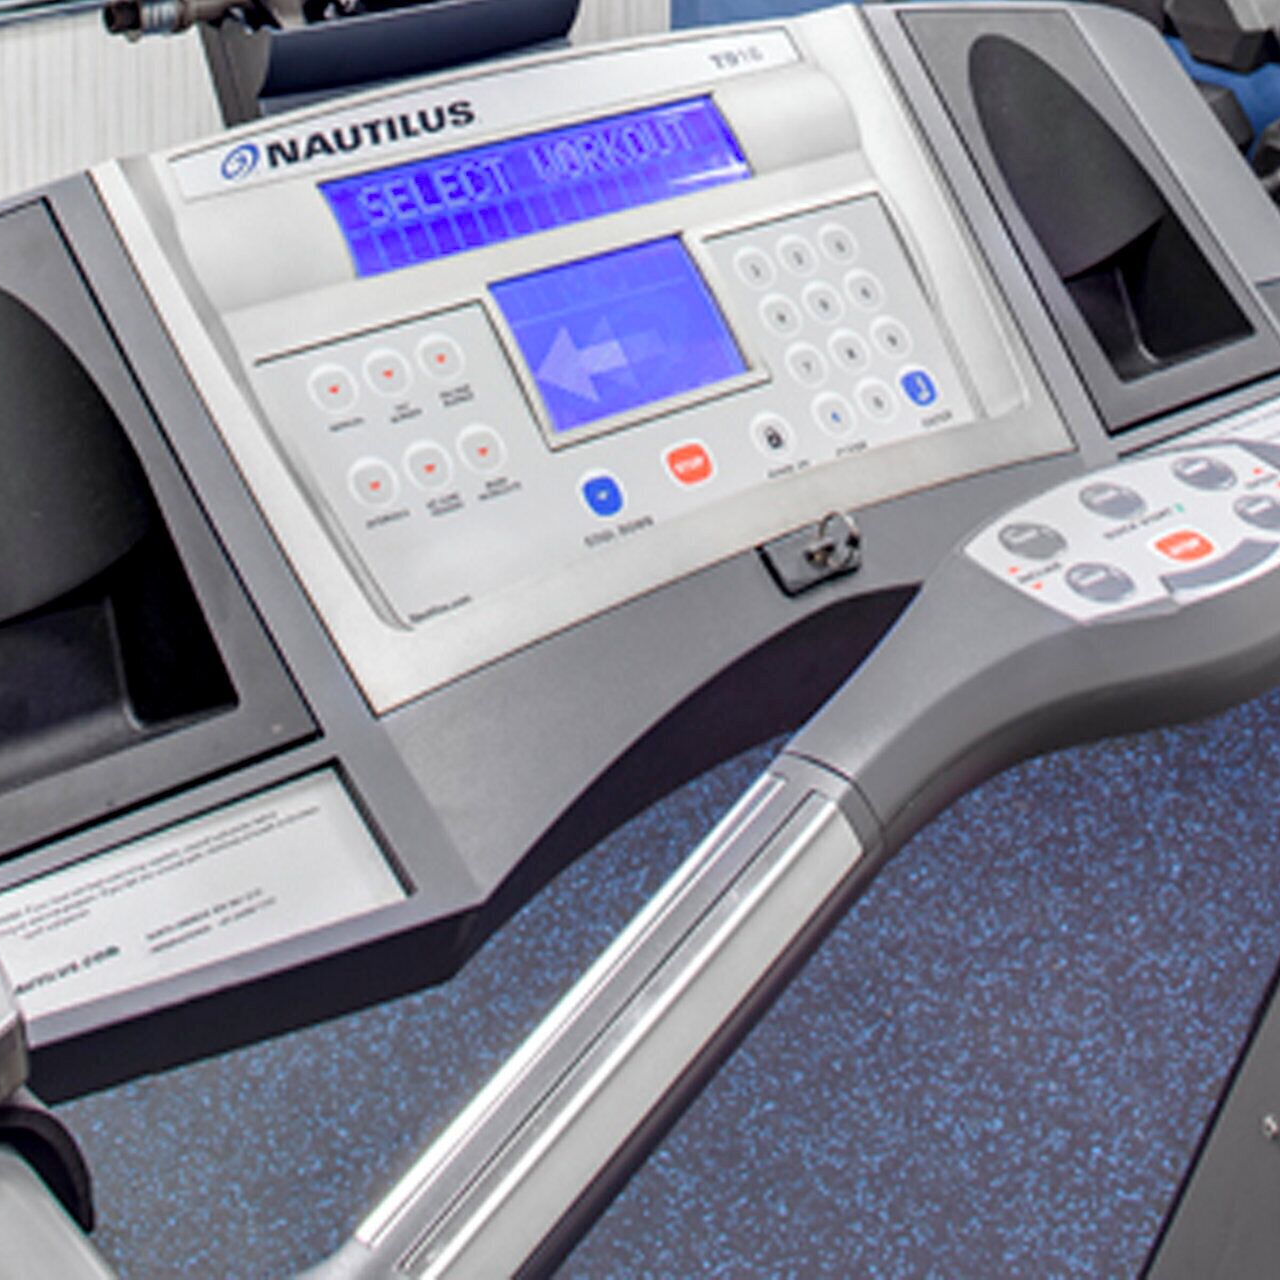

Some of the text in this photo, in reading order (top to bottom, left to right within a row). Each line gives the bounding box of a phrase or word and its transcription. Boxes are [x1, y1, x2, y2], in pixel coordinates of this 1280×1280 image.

[266, 100, 475, 168] NAUTILUS
[358, 113, 693, 228] SELECT WORKOUT
